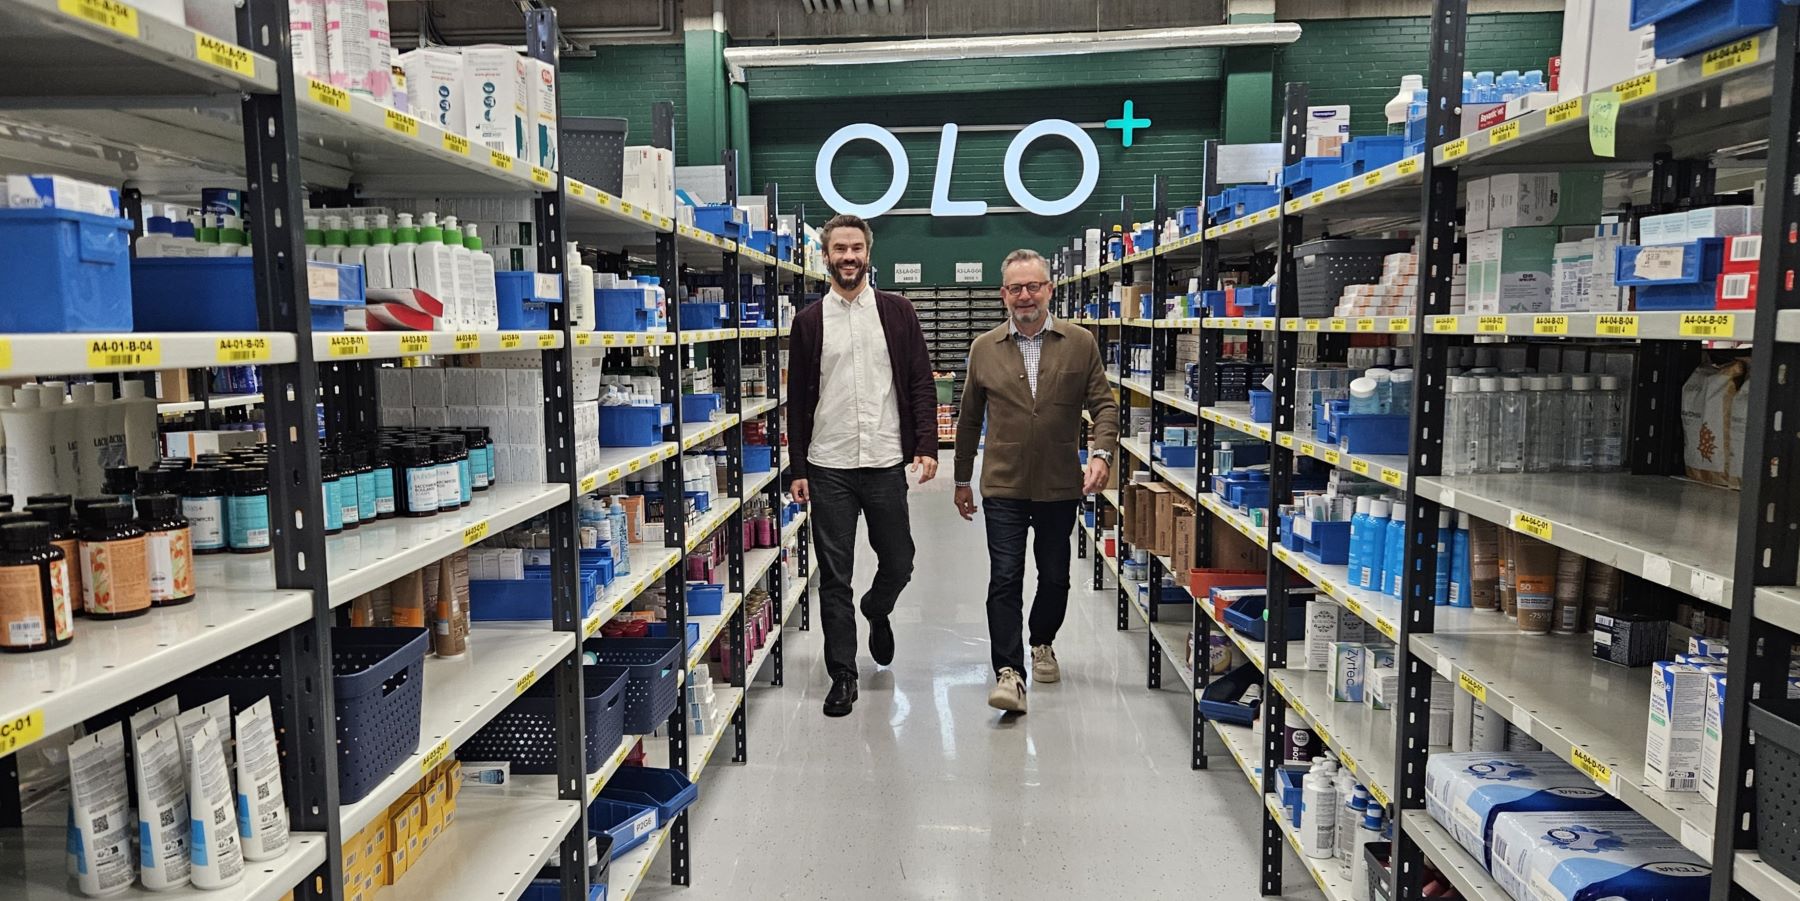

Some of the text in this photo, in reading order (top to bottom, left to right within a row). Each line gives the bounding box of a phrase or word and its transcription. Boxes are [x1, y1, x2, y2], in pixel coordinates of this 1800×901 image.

[1600, 317, 1633, 325] A4-04-B-04
[1684, 315, 1728, 325] A4-04-B-05
[220, 339, 264, 349] A4-01-B-05
[331, 336, 364, 345] A4-03-B-01
[93, 341, 153, 352] A4-01-B-04
[1521, 515, 1548, 530] A4-04-C-01
[1345, 649, 1359, 686] Zyrtec
[1574, 749, 1606, 774] A4-04-D-02
